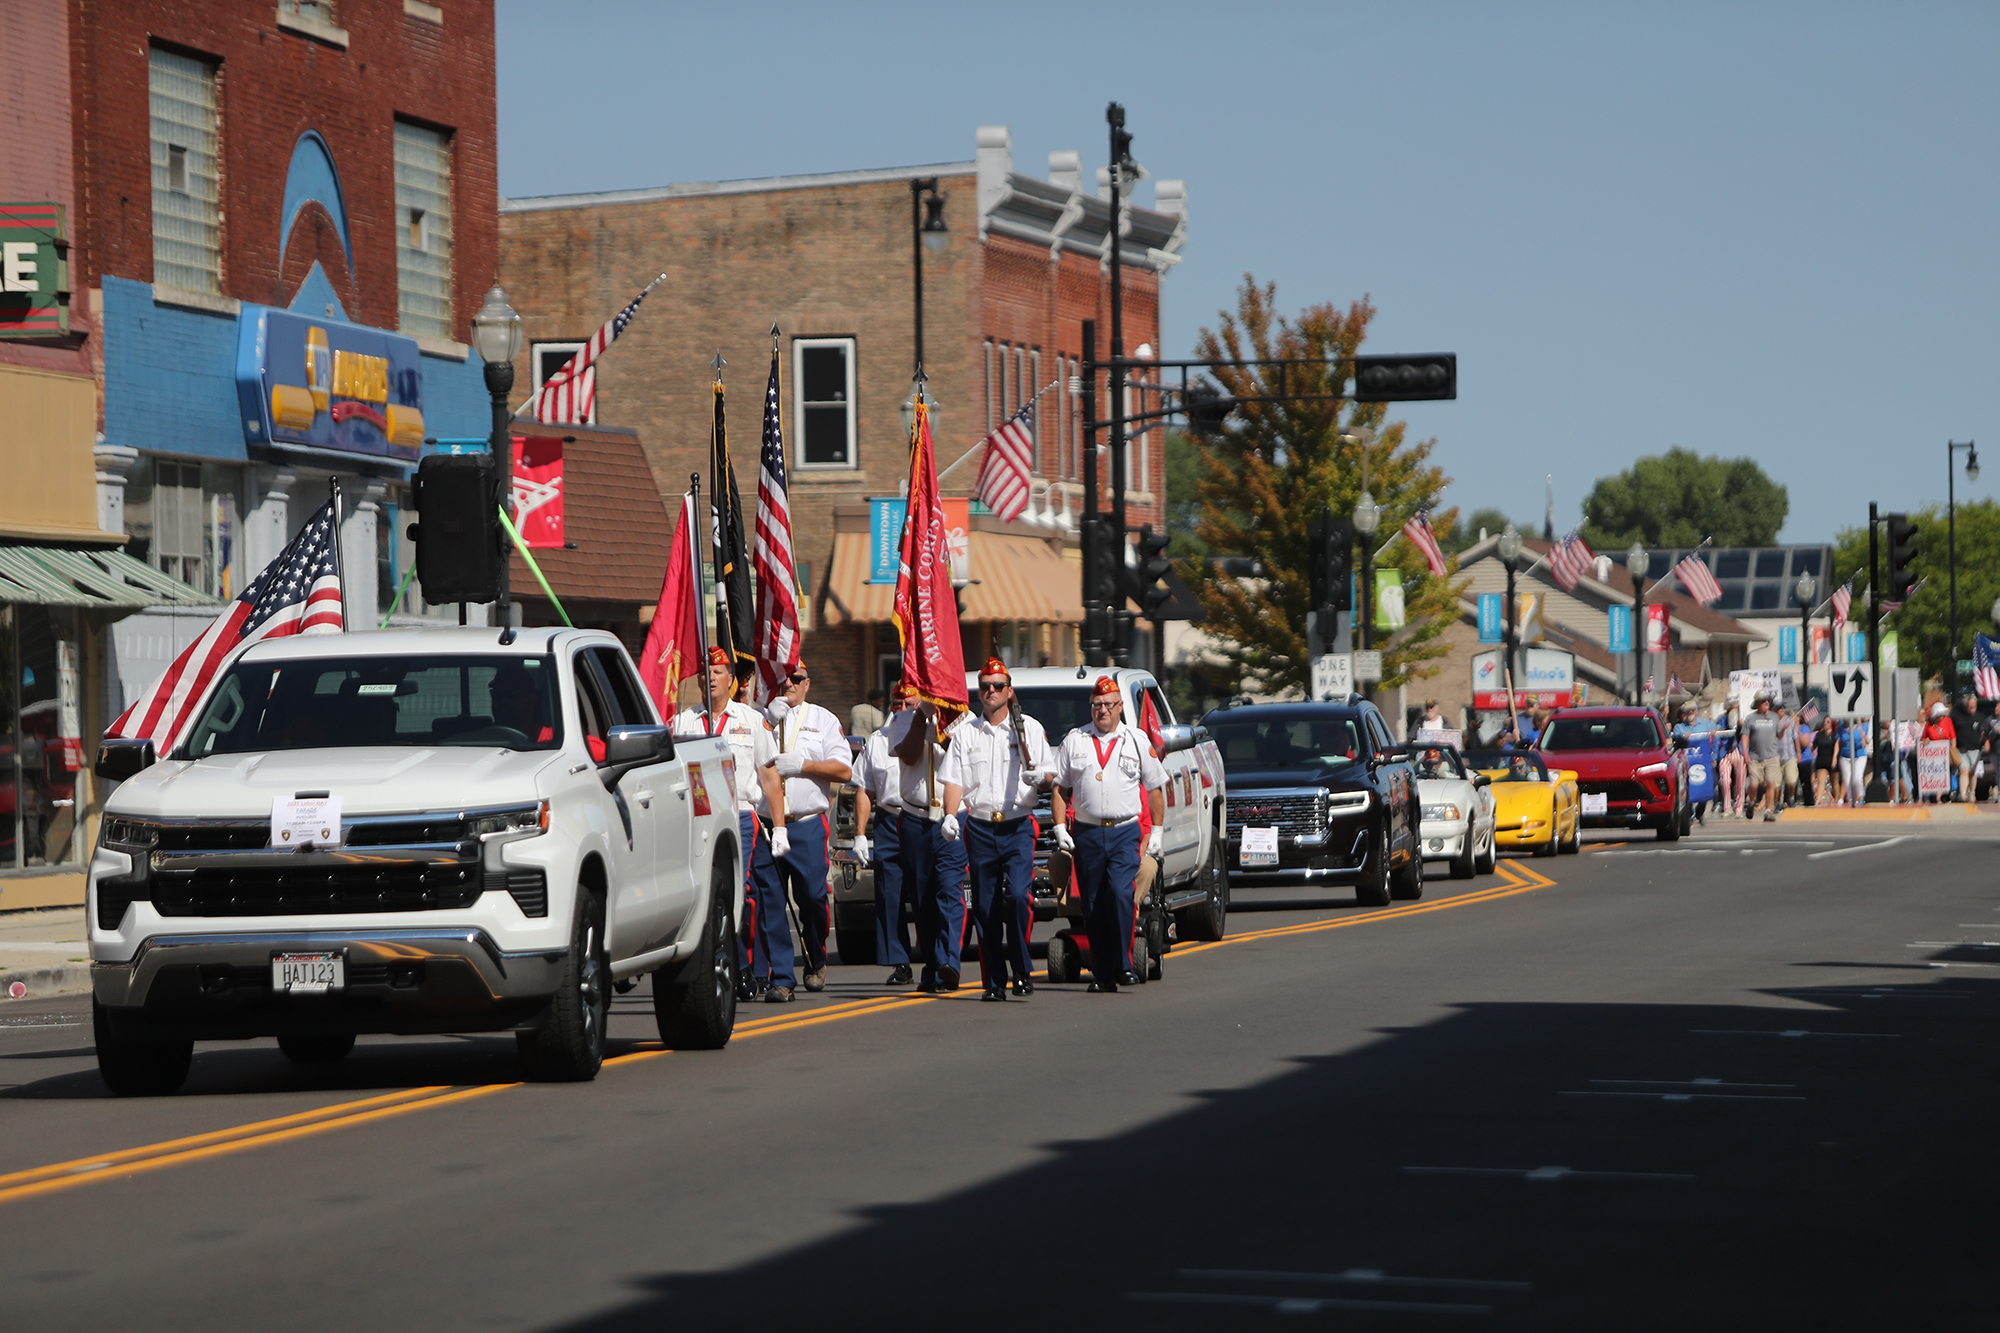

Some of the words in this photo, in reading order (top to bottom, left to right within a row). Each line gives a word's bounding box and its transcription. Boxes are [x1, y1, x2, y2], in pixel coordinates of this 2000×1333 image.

[880, 502, 890, 566] DOWNTOWN
[892, 525, 899, 537] DU
[918, 517, 941, 581] CORPS
[917, 586, 943, 664] MARINE
[1320, 658, 1347, 671] ONE
[1319, 674, 1347, 687] WAY
[1762, 669, 1779, 679] OFF
[1919, 742, 1948, 758] Preserve
[1919, 759, 1947, 774] Protect
[1920, 775, 1948, 790] Defend
[1235, 805, 1281, 816] GMC
[283, 963, 335, 981] HAT123
[290, 981, 329, 991] Holiday
